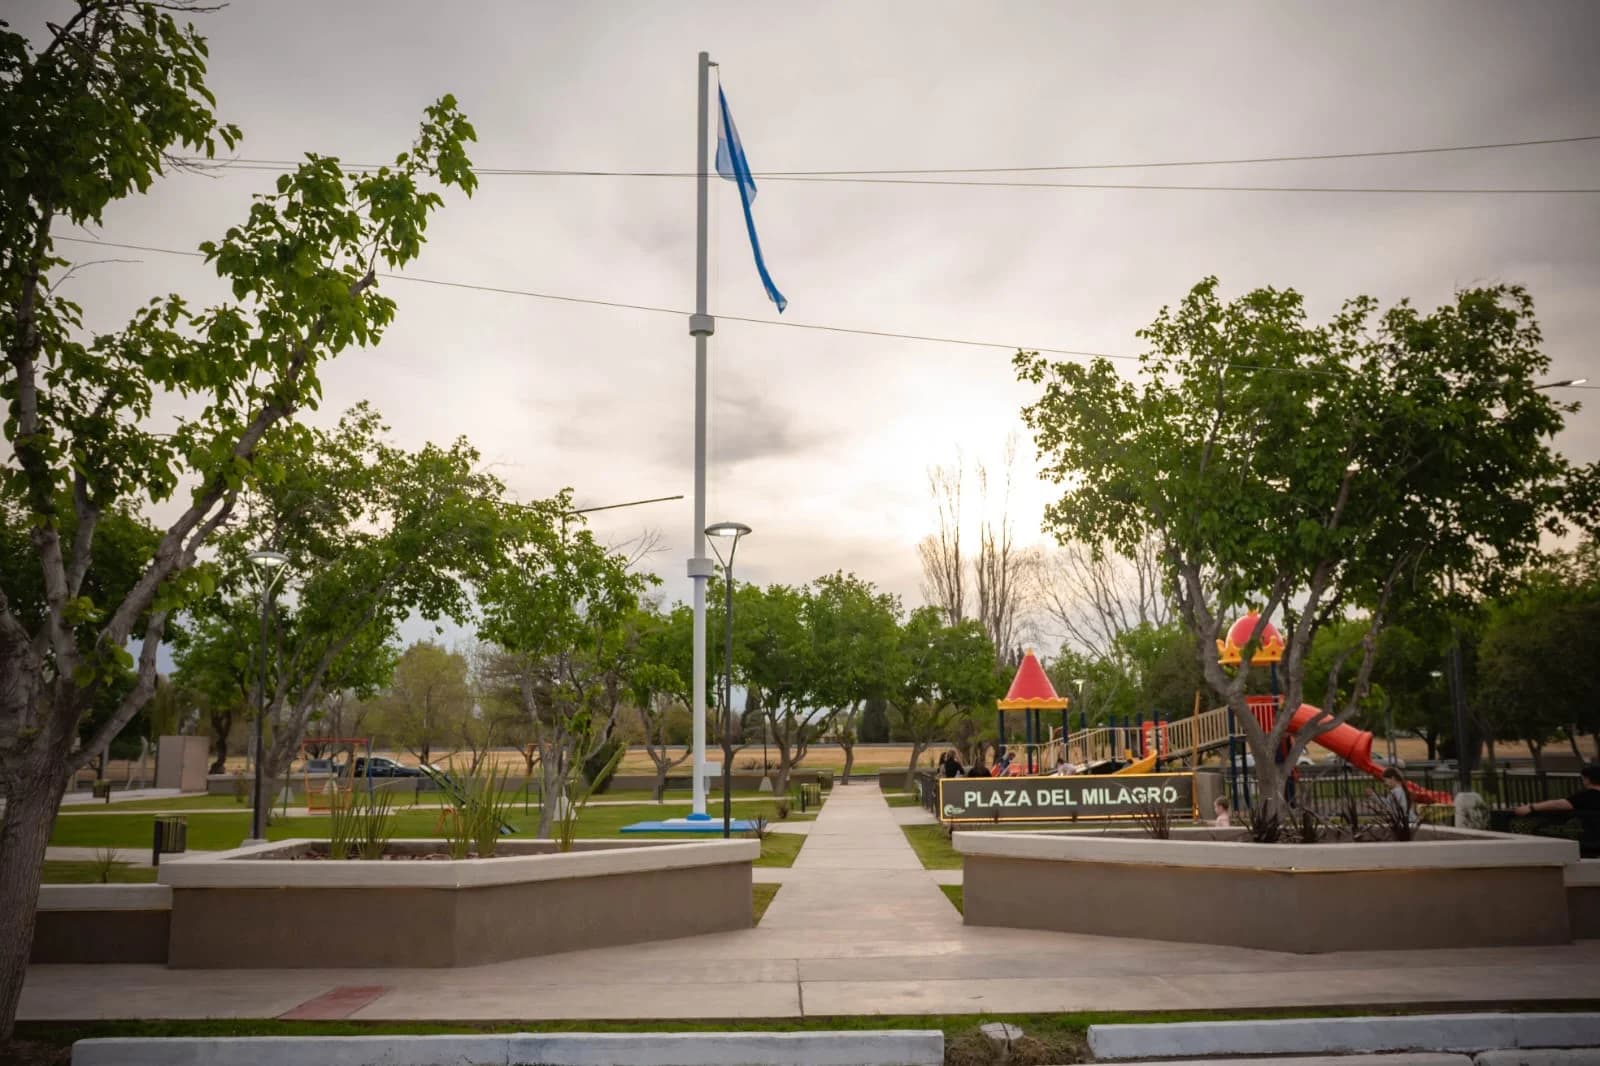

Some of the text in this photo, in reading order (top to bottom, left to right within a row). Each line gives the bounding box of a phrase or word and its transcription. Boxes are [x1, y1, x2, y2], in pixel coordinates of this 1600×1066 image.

[964, 786, 1178, 807] PLAZA DEL MILAGRO
